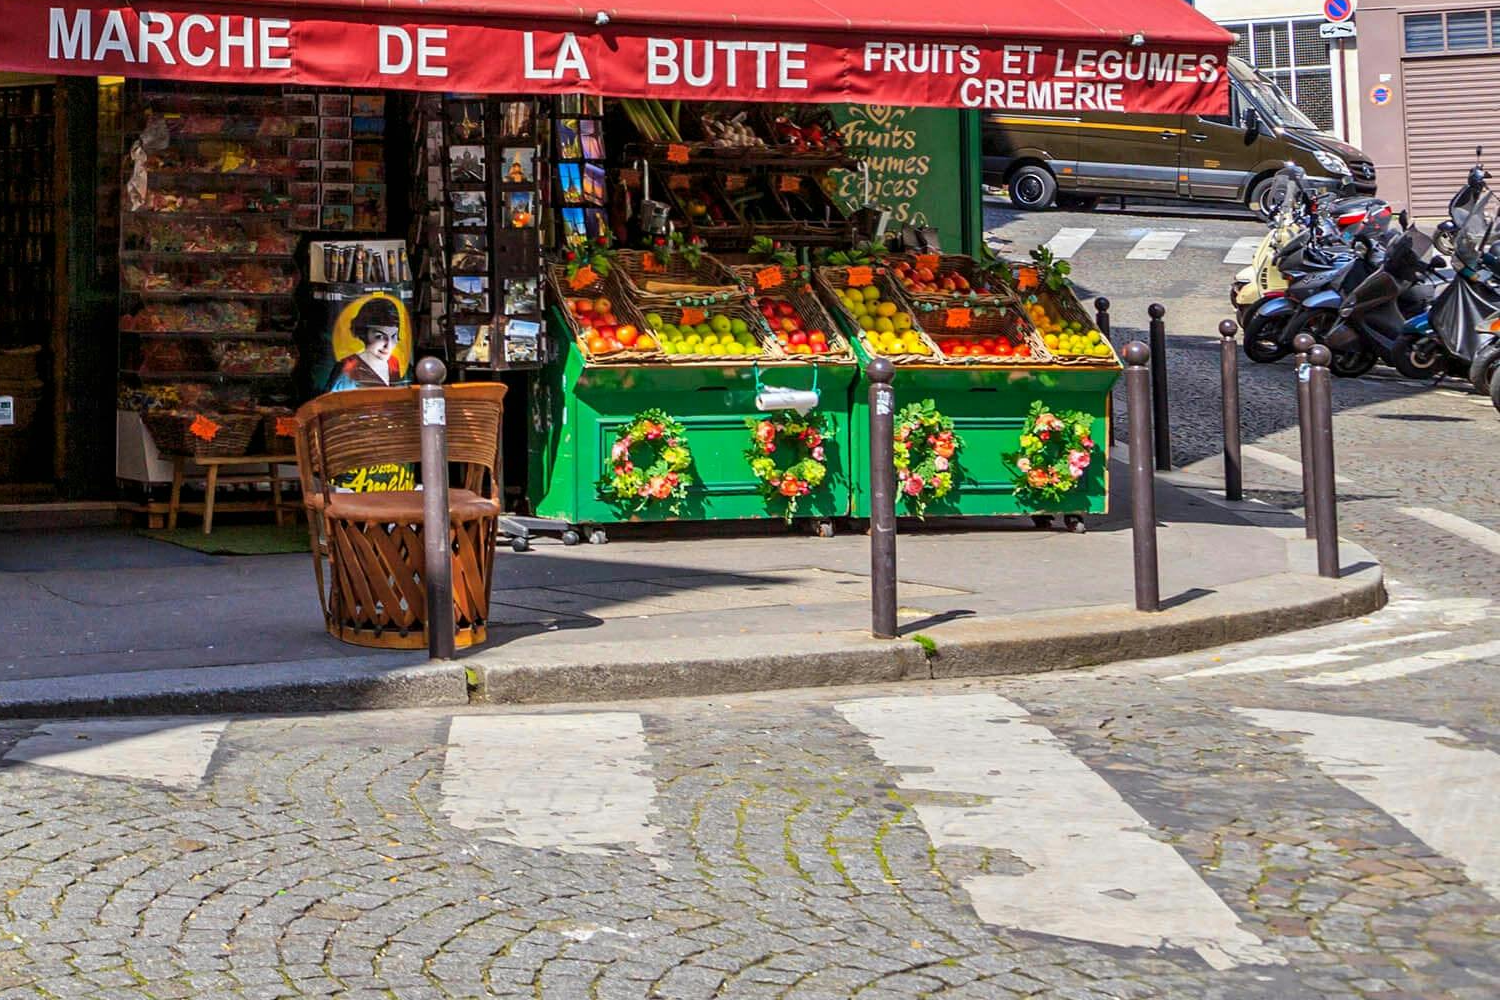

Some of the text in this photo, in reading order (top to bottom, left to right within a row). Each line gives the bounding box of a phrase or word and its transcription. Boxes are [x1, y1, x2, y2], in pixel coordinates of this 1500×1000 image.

[48, 6, 292, 70] MARCHE
[378, 25, 448, 77] DE
[523, 31, 591, 80] LA
[647, 37, 808, 89] BUTTE
[863, 42, 1219, 83] FRUITS ET LEGUMES
[960, 78, 1125, 112] CREMERIE
[840, 120, 916, 149] Fruits
